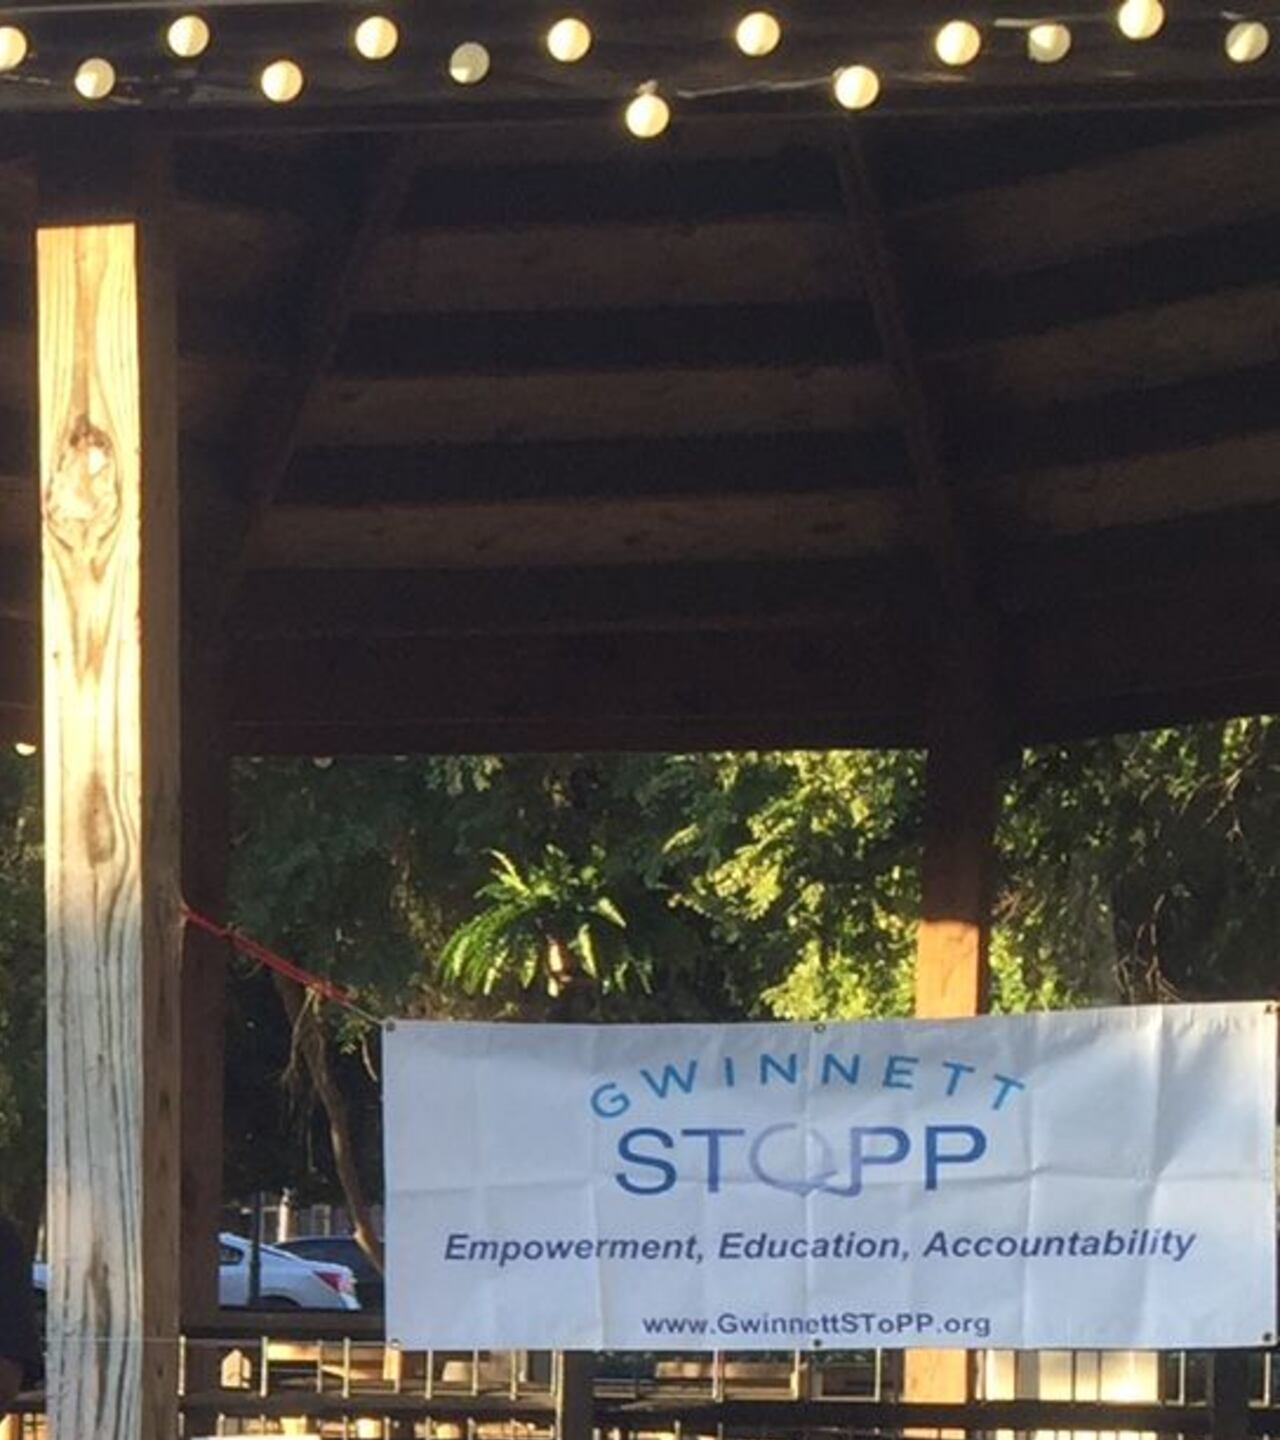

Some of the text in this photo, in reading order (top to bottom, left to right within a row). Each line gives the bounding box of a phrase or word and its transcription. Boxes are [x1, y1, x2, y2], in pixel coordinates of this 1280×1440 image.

[590, 1052, 1026, 1119] GWINNETT
[443, 1229, 1196, 1267] Empowerment, Education, Accountability
[642, 1312, 991, 1338] www.GwinnettSToPP.org
